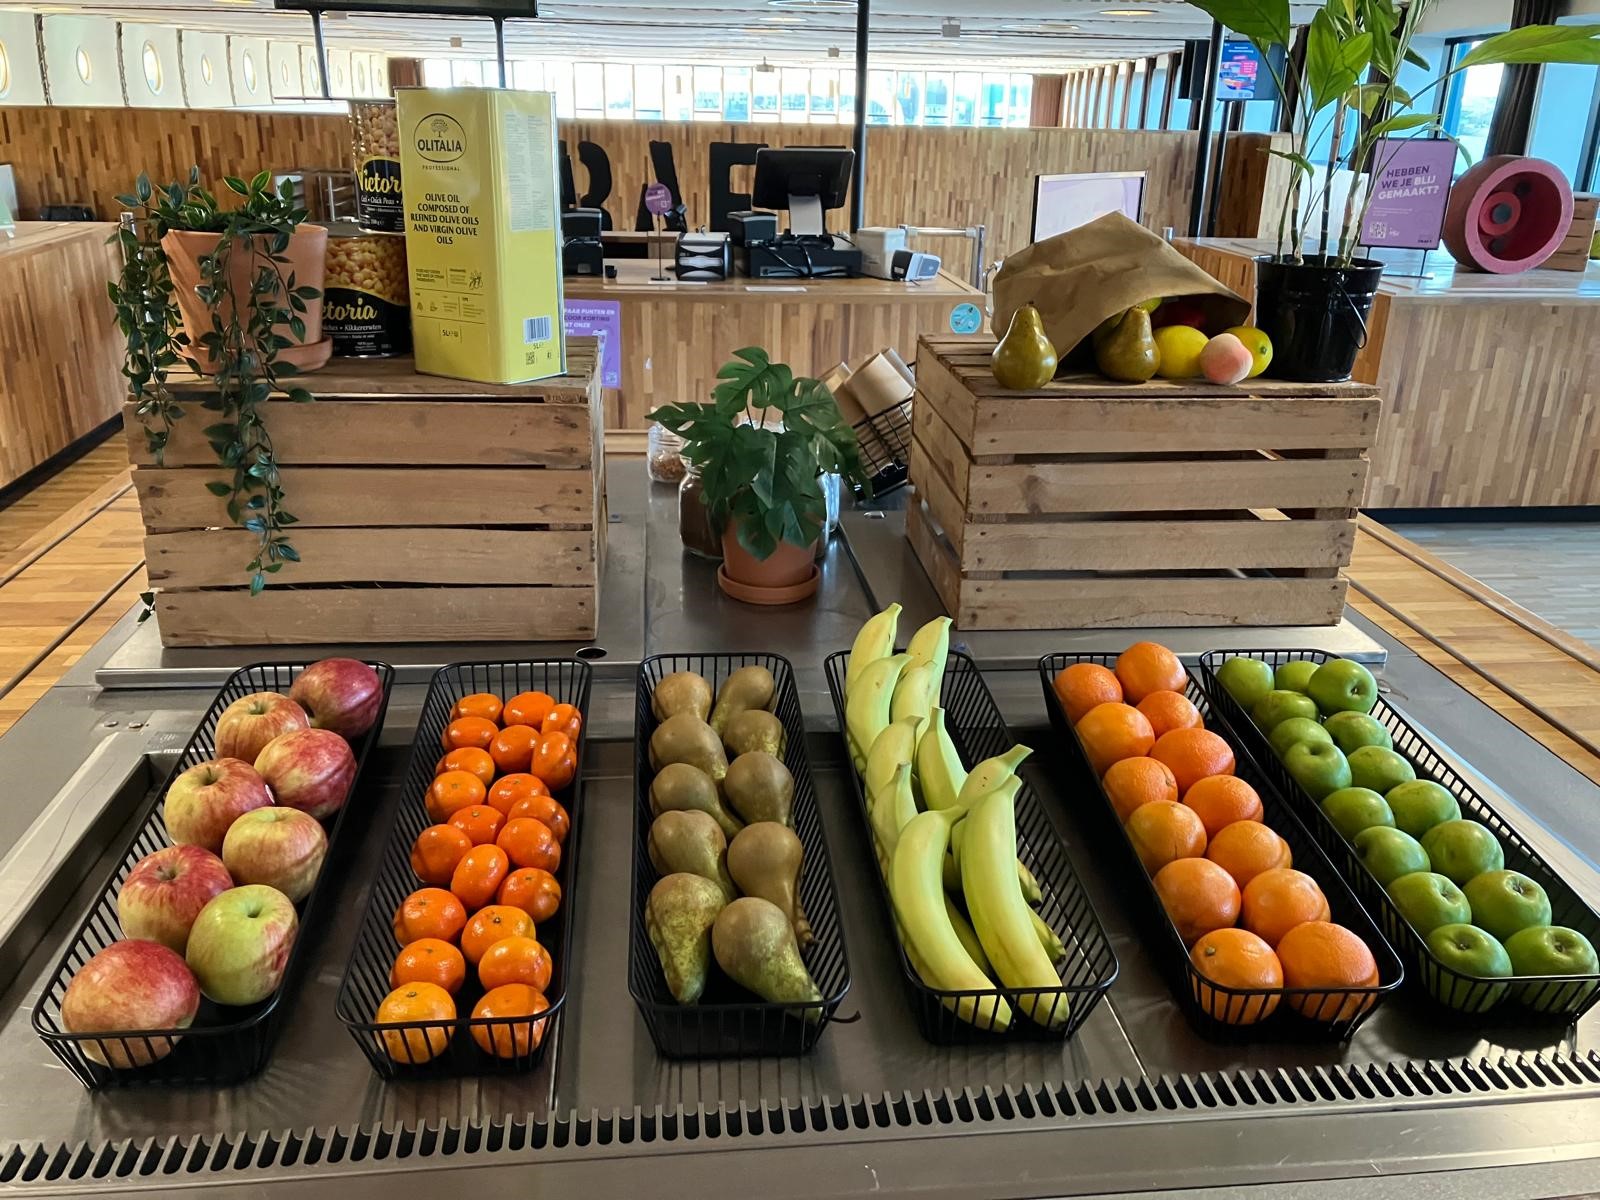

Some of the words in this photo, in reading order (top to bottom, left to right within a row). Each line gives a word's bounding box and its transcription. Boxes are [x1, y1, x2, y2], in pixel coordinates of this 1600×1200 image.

[417, 139, 462, 152] OLITALIA
[1386, 165, 1431, 178] HEBBEN
[1381, 179, 1399, 189] WE
[1400, 178, 1412, 187] JE
[1413, 175, 1437, 186] BLIJ
[425, 193, 446, 202] OLIVE
[447, 194, 460, 203] OIL
[1378, 185, 1440, 200] GEMAAKT?
[417, 203, 459, 214] COMPOSED
[459, 205, 470, 214] OF
[410, 214, 438, 223] REFINED
[439, 215, 460, 224] OLIVE
[461, 216, 479, 225] OILS
[413, 224, 429, 233] AND
[430, 225, 454, 235] VIRGIN
[455, 226, 477, 236] OLIVE
[436, 235, 454, 245] OILS
